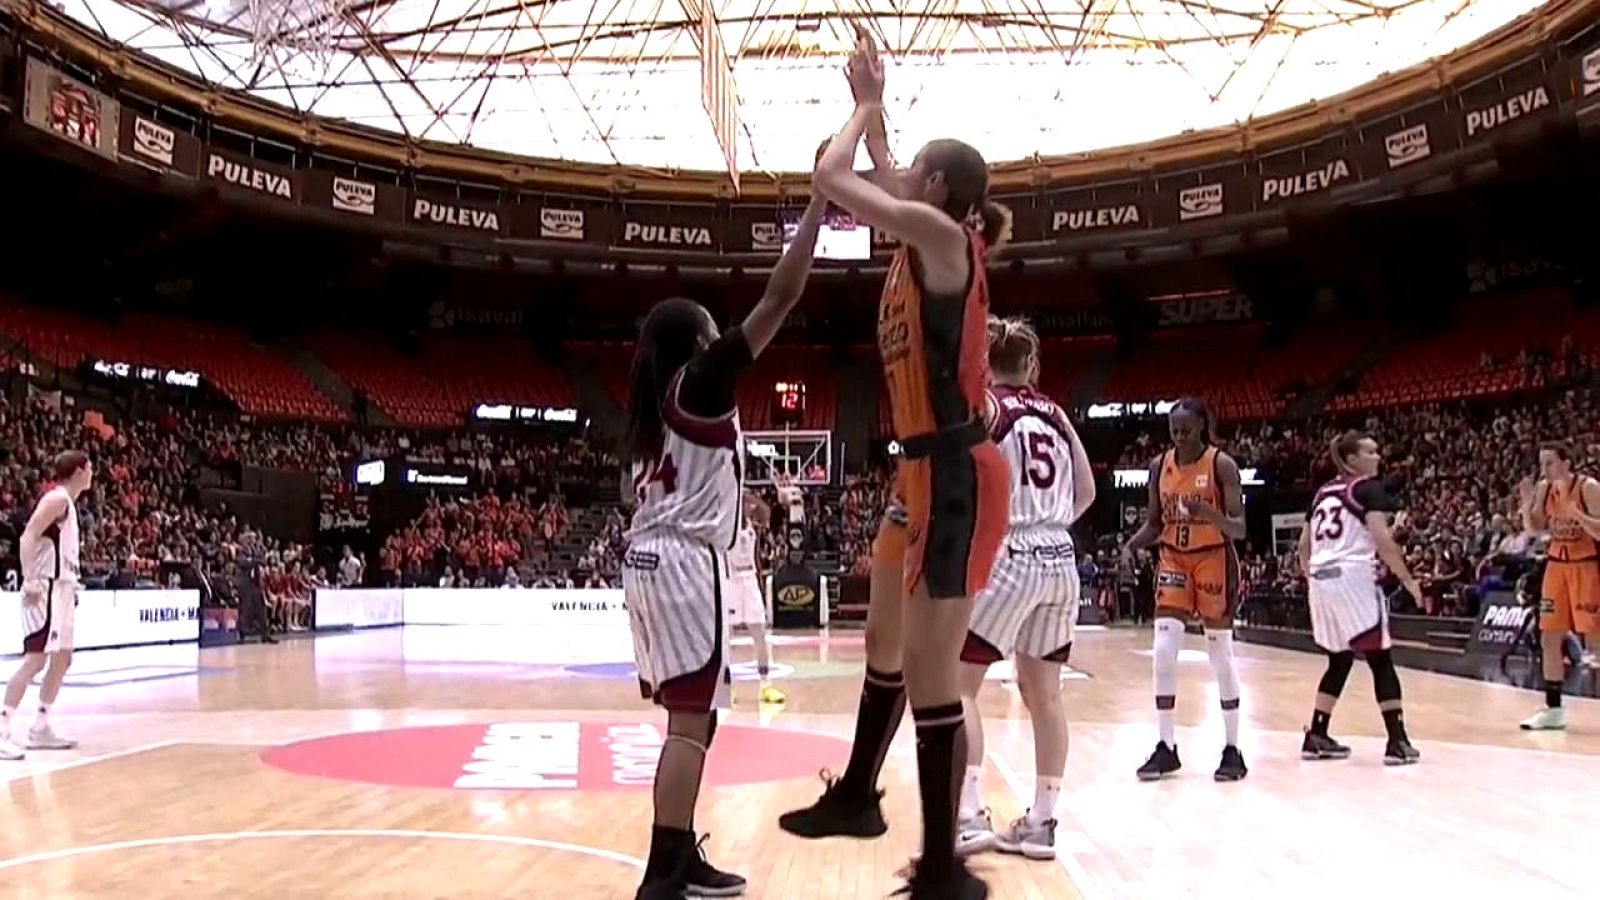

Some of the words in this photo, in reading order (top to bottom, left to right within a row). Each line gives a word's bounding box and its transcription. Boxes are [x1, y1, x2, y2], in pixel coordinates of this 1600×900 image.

[1466, 87, 1549, 136] PULEVA
[138, 122, 172, 145] PULEVA
[1388, 130, 1426, 149] PULEVA
[207, 154, 292, 198] PULEVA
[1263, 159, 1349, 202] PULEVA
[335, 181, 373, 198] PULEVA
[1183, 188, 1221, 204] PULEVA
[413, 199, 499, 230] PULEVA
[543, 209, 582, 225] PULEVA
[1053, 205, 1140, 231] PULEVA
[624, 221, 711, 245] PULEVA
[782, 393, 798, 408] 12
[1017, 431, 1056, 490] 15
[1315, 506, 1343, 541] 23
[1175, 526, 1190, 547] 13
[783, 588, 810, 601] AP
[139, 608, 179, 623] VALENCIA
